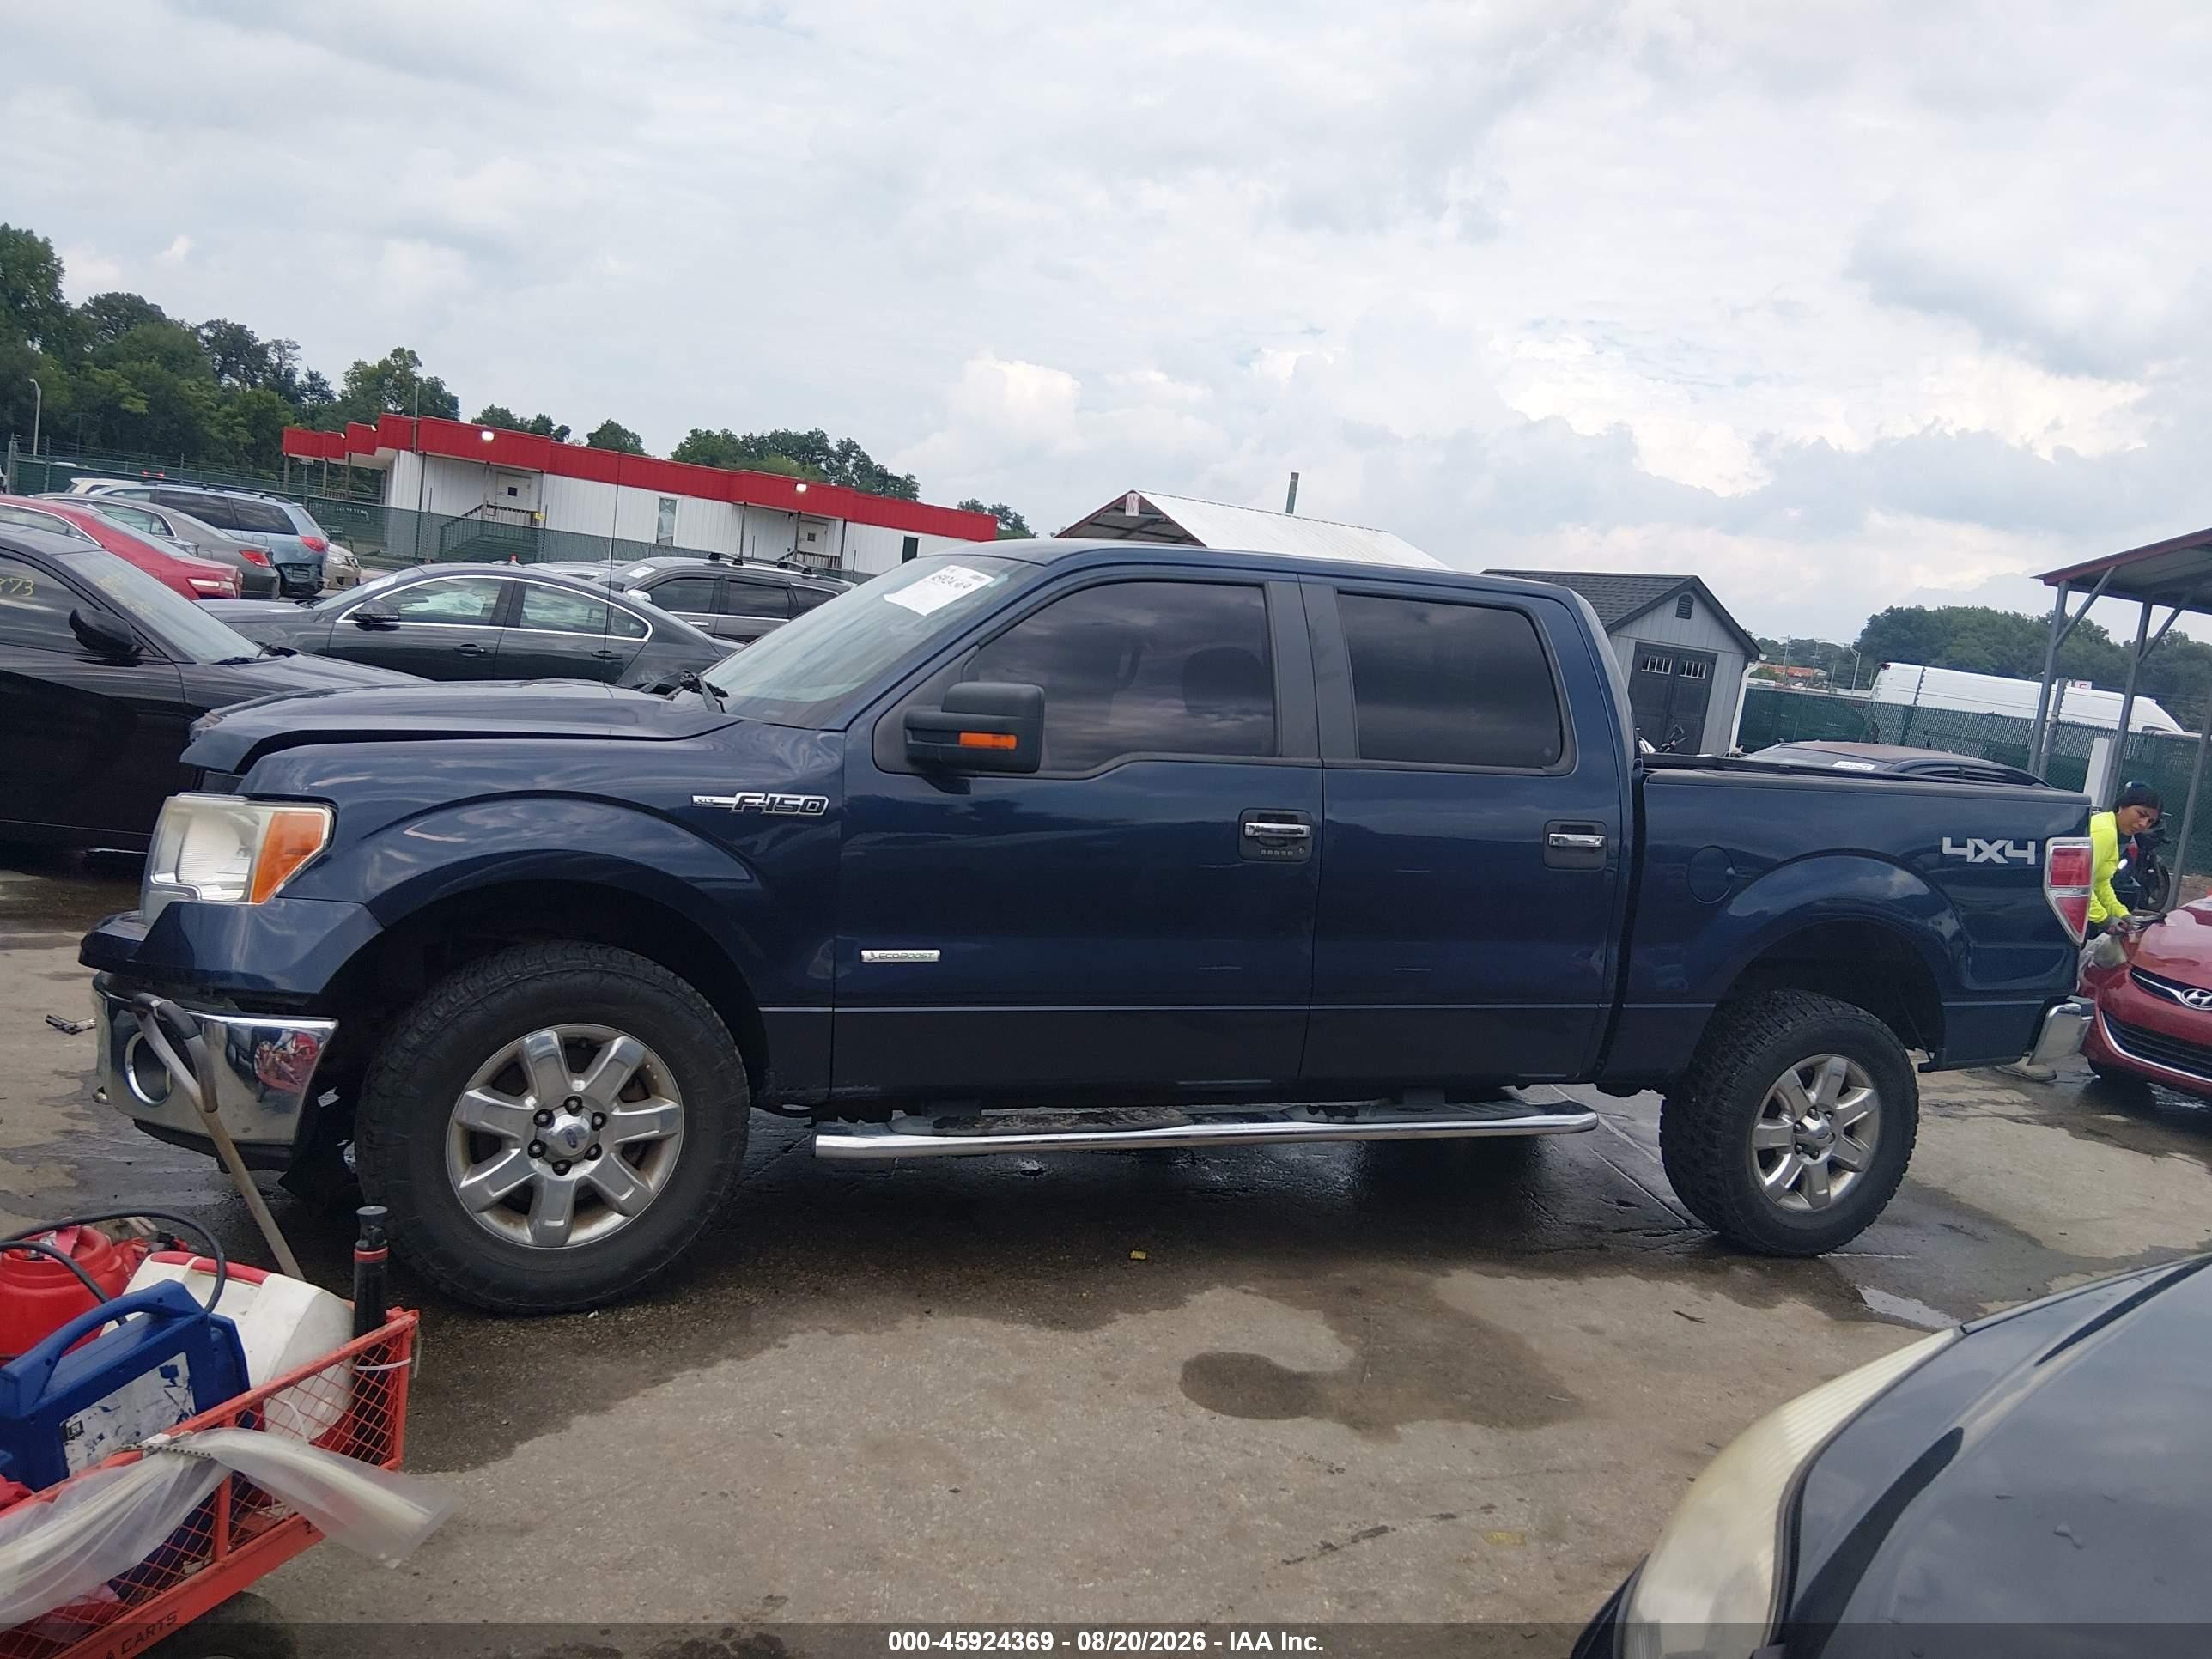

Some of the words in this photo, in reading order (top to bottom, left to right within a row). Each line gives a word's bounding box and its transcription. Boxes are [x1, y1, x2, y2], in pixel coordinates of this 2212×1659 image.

[733, 793, 829, 816] F-150
[1942, 836, 2036, 865] 4X4
[121, 1610, 179, 1656] CARTS
